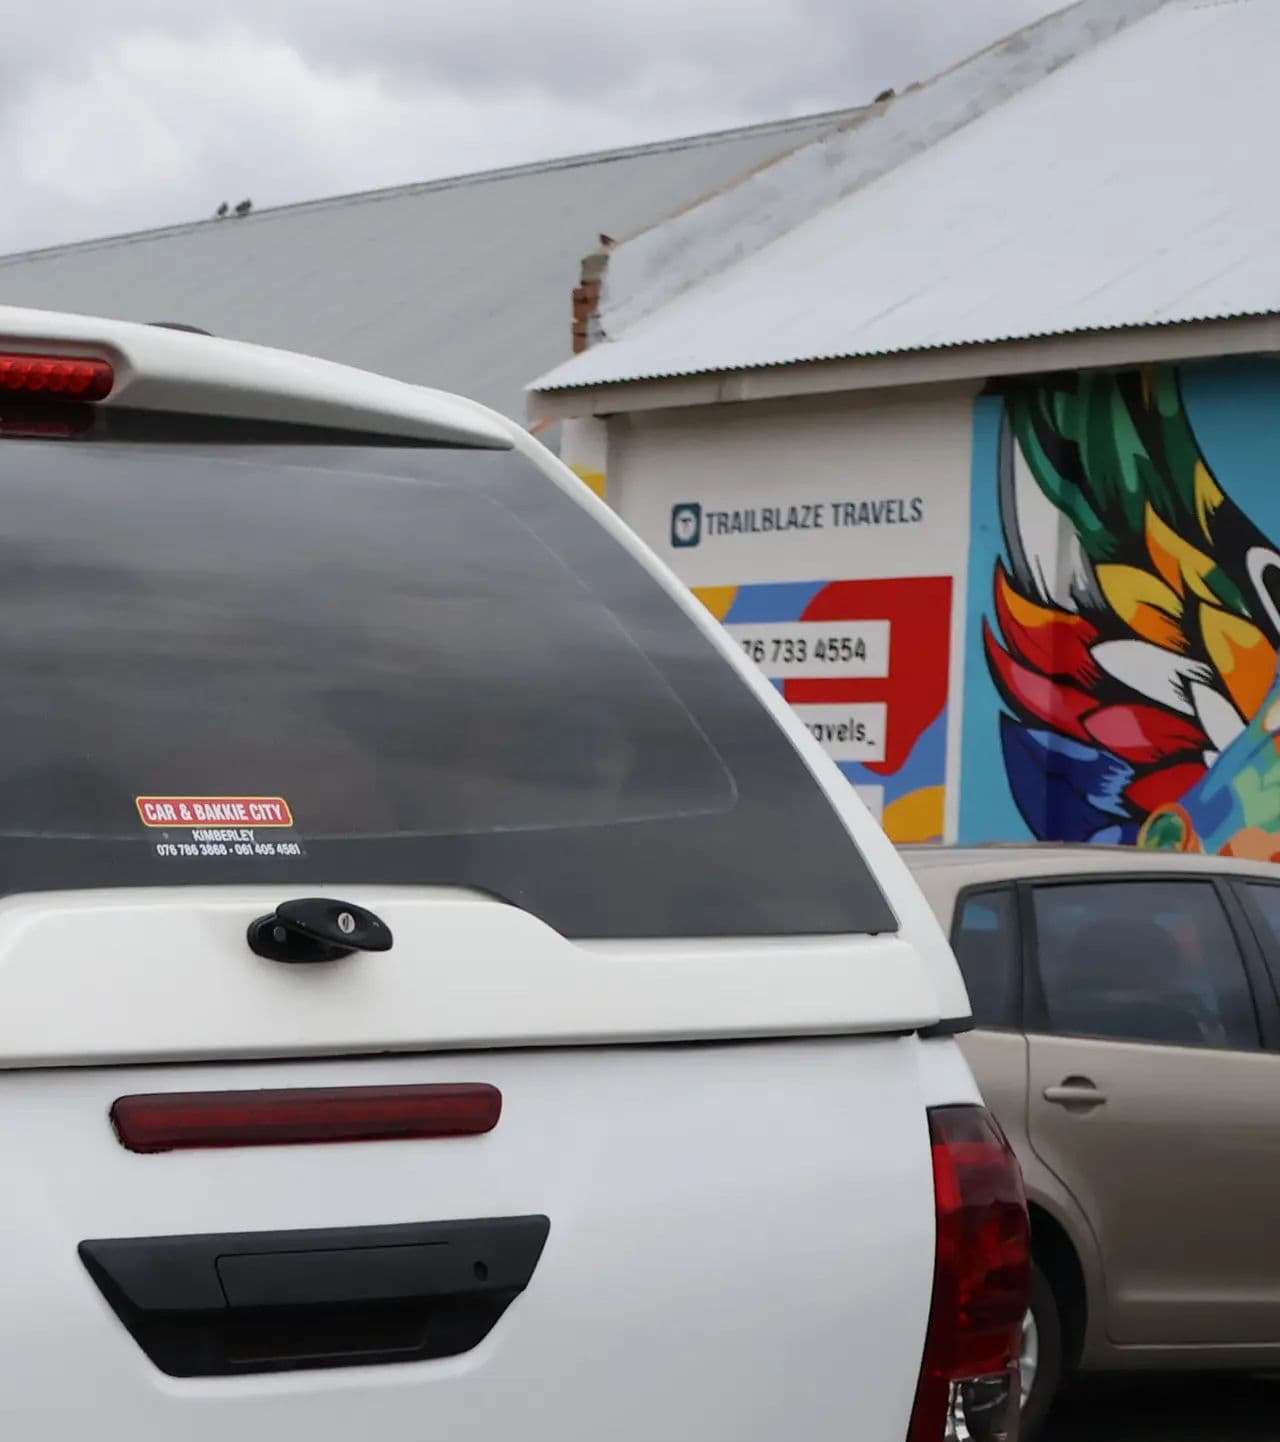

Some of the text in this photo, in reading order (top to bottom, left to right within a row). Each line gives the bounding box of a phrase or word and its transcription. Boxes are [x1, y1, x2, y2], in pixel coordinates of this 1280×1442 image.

[705, 504, 824, 535] TRAILBLAZE
[831, 497, 923, 527] TRAVELS
[771, 639, 807, 663] 733
[814, 637, 866, 662] 4554
[144, 803, 282, 821] CAR & BAKKIE CITY
[192, 829, 255, 842] KIMBERLEY
[255, 844, 275, 856] 405
